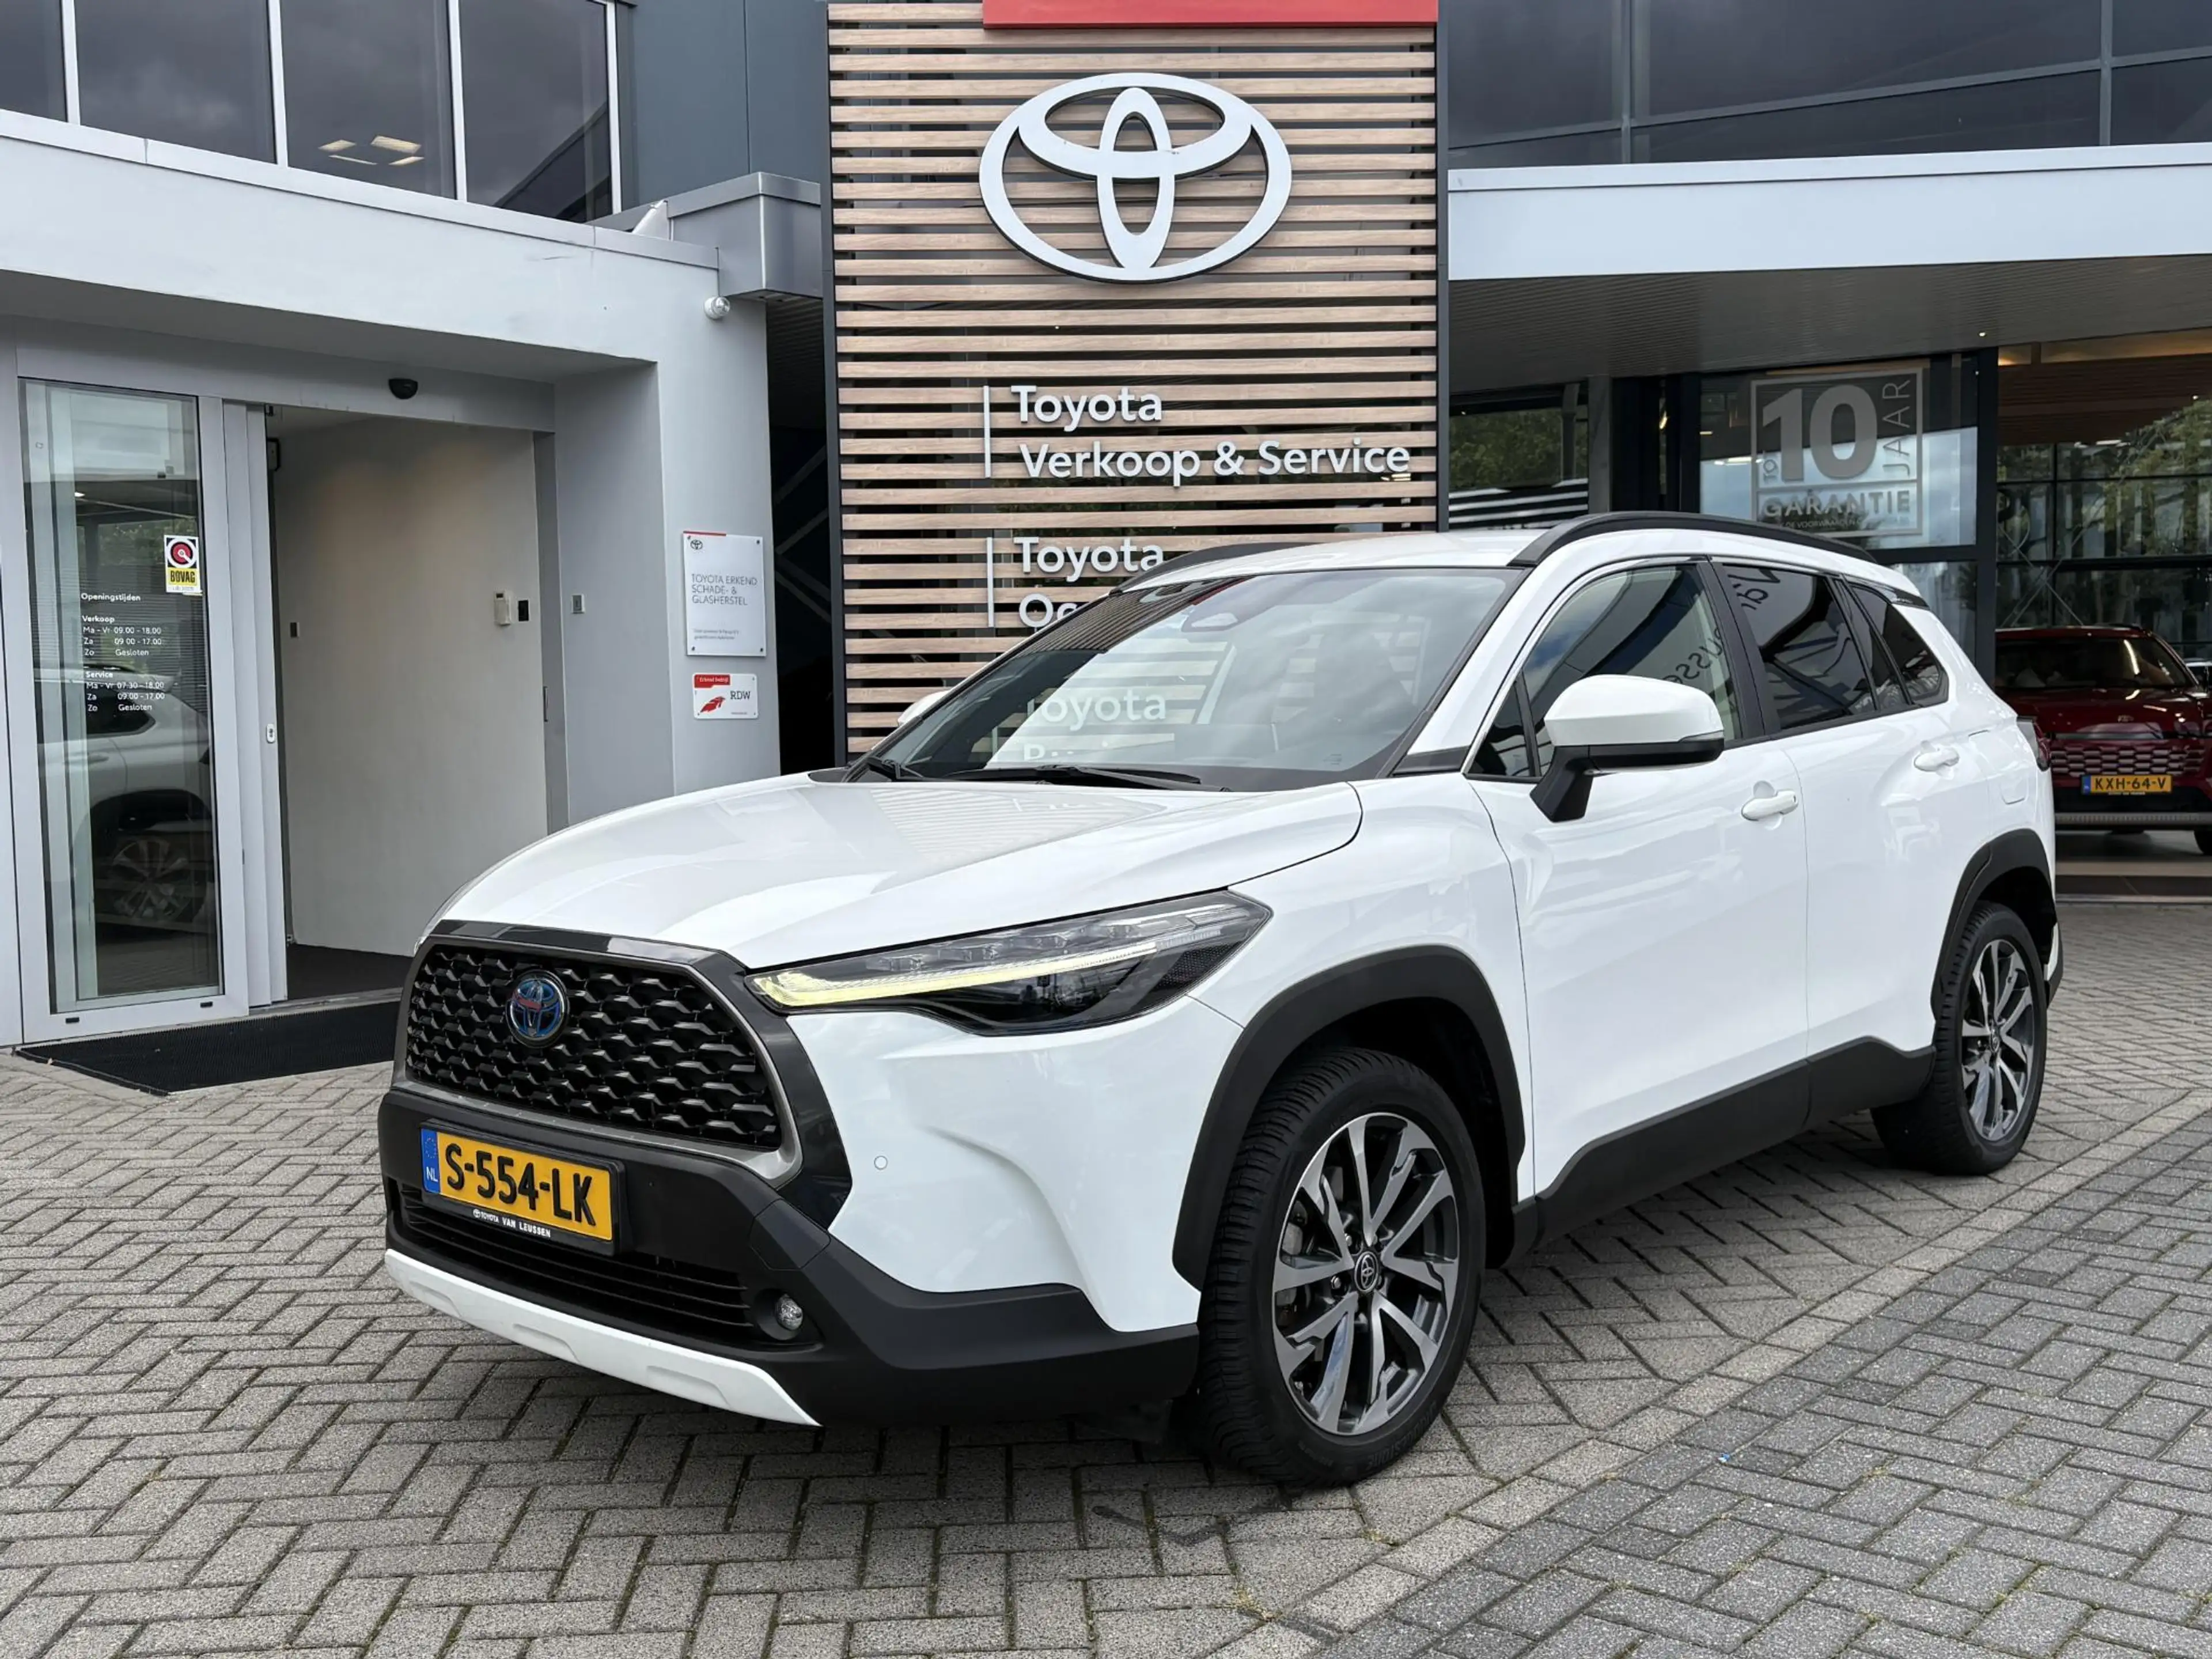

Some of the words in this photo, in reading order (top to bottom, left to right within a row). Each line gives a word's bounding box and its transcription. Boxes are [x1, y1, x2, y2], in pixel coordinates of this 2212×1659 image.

[1011, 385, 1162, 431] Toyota
[1763, 385, 1877, 483] 10
[1882, 380, 1911, 478] JAAR
[1018, 442, 1200, 488] Verkoop
[1213, 440, 1244, 475] &
[1258, 437, 1410, 475] Service
[1764, 490, 1911, 518] GARANTIE
[1013, 536, 1164, 582] Toyota
[170, 570, 195, 583] BOVAG
[691, 573, 724, 584] TOYOTA
[725, 575, 758, 586] ERKEND
[691, 584, 729, 595] SCHADE-
[731, 586, 737, 595] &
[81, 592, 141, 603] Openingstijden
[692, 594, 748, 606] GLASHERSTEL
[82, 615, 115, 624] Verkoop
[86, 681, 98, 690] Ma
[730, 690, 751, 700] RDW
[88, 704, 99, 712] Zo
[1028, 688, 1166, 732] oyota
[2094, 778, 2166, 790] KXH-64-V
[426, 1166, 439, 1183] NL
[445, 1143, 597, 1226] S-554-LK
[480, 1211, 499, 1224] TOYOTA
[502, 1217, 516, 1229] VAN
[518, 1221, 551, 1238] LEUSSEN
